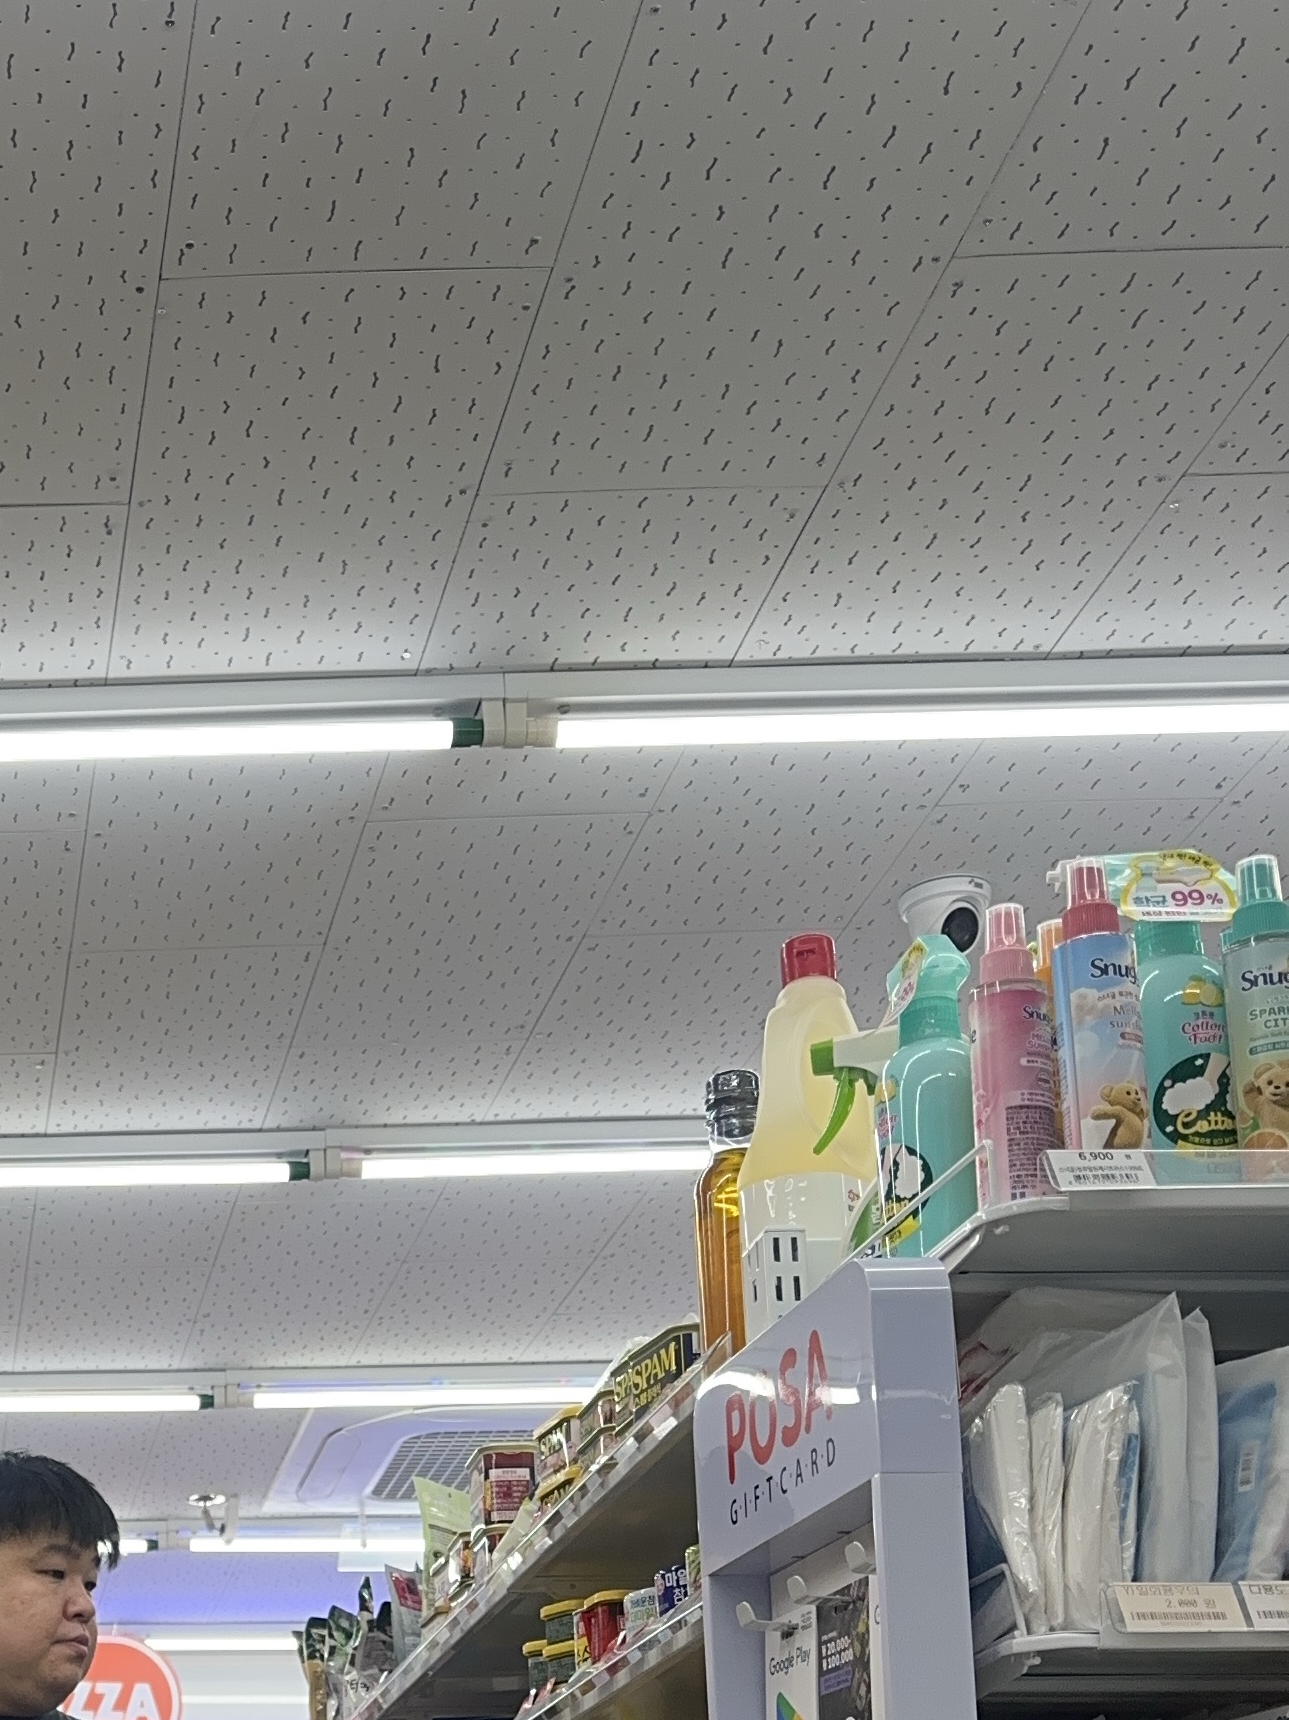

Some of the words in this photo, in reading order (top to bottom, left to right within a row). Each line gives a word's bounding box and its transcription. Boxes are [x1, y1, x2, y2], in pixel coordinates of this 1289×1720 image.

[1170, 888, 1224, 908] 99%
[1181, 1019, 1226, 1035] Cotton
[1078, 1152, 1114, 1162] 6,900
[631, 1341, 677, 1388] SPAM
[725, 1328, 833, 1485] POSA
[769, 1651, 795, 1677] Google
[795, 1644, 811, 1667] Play
